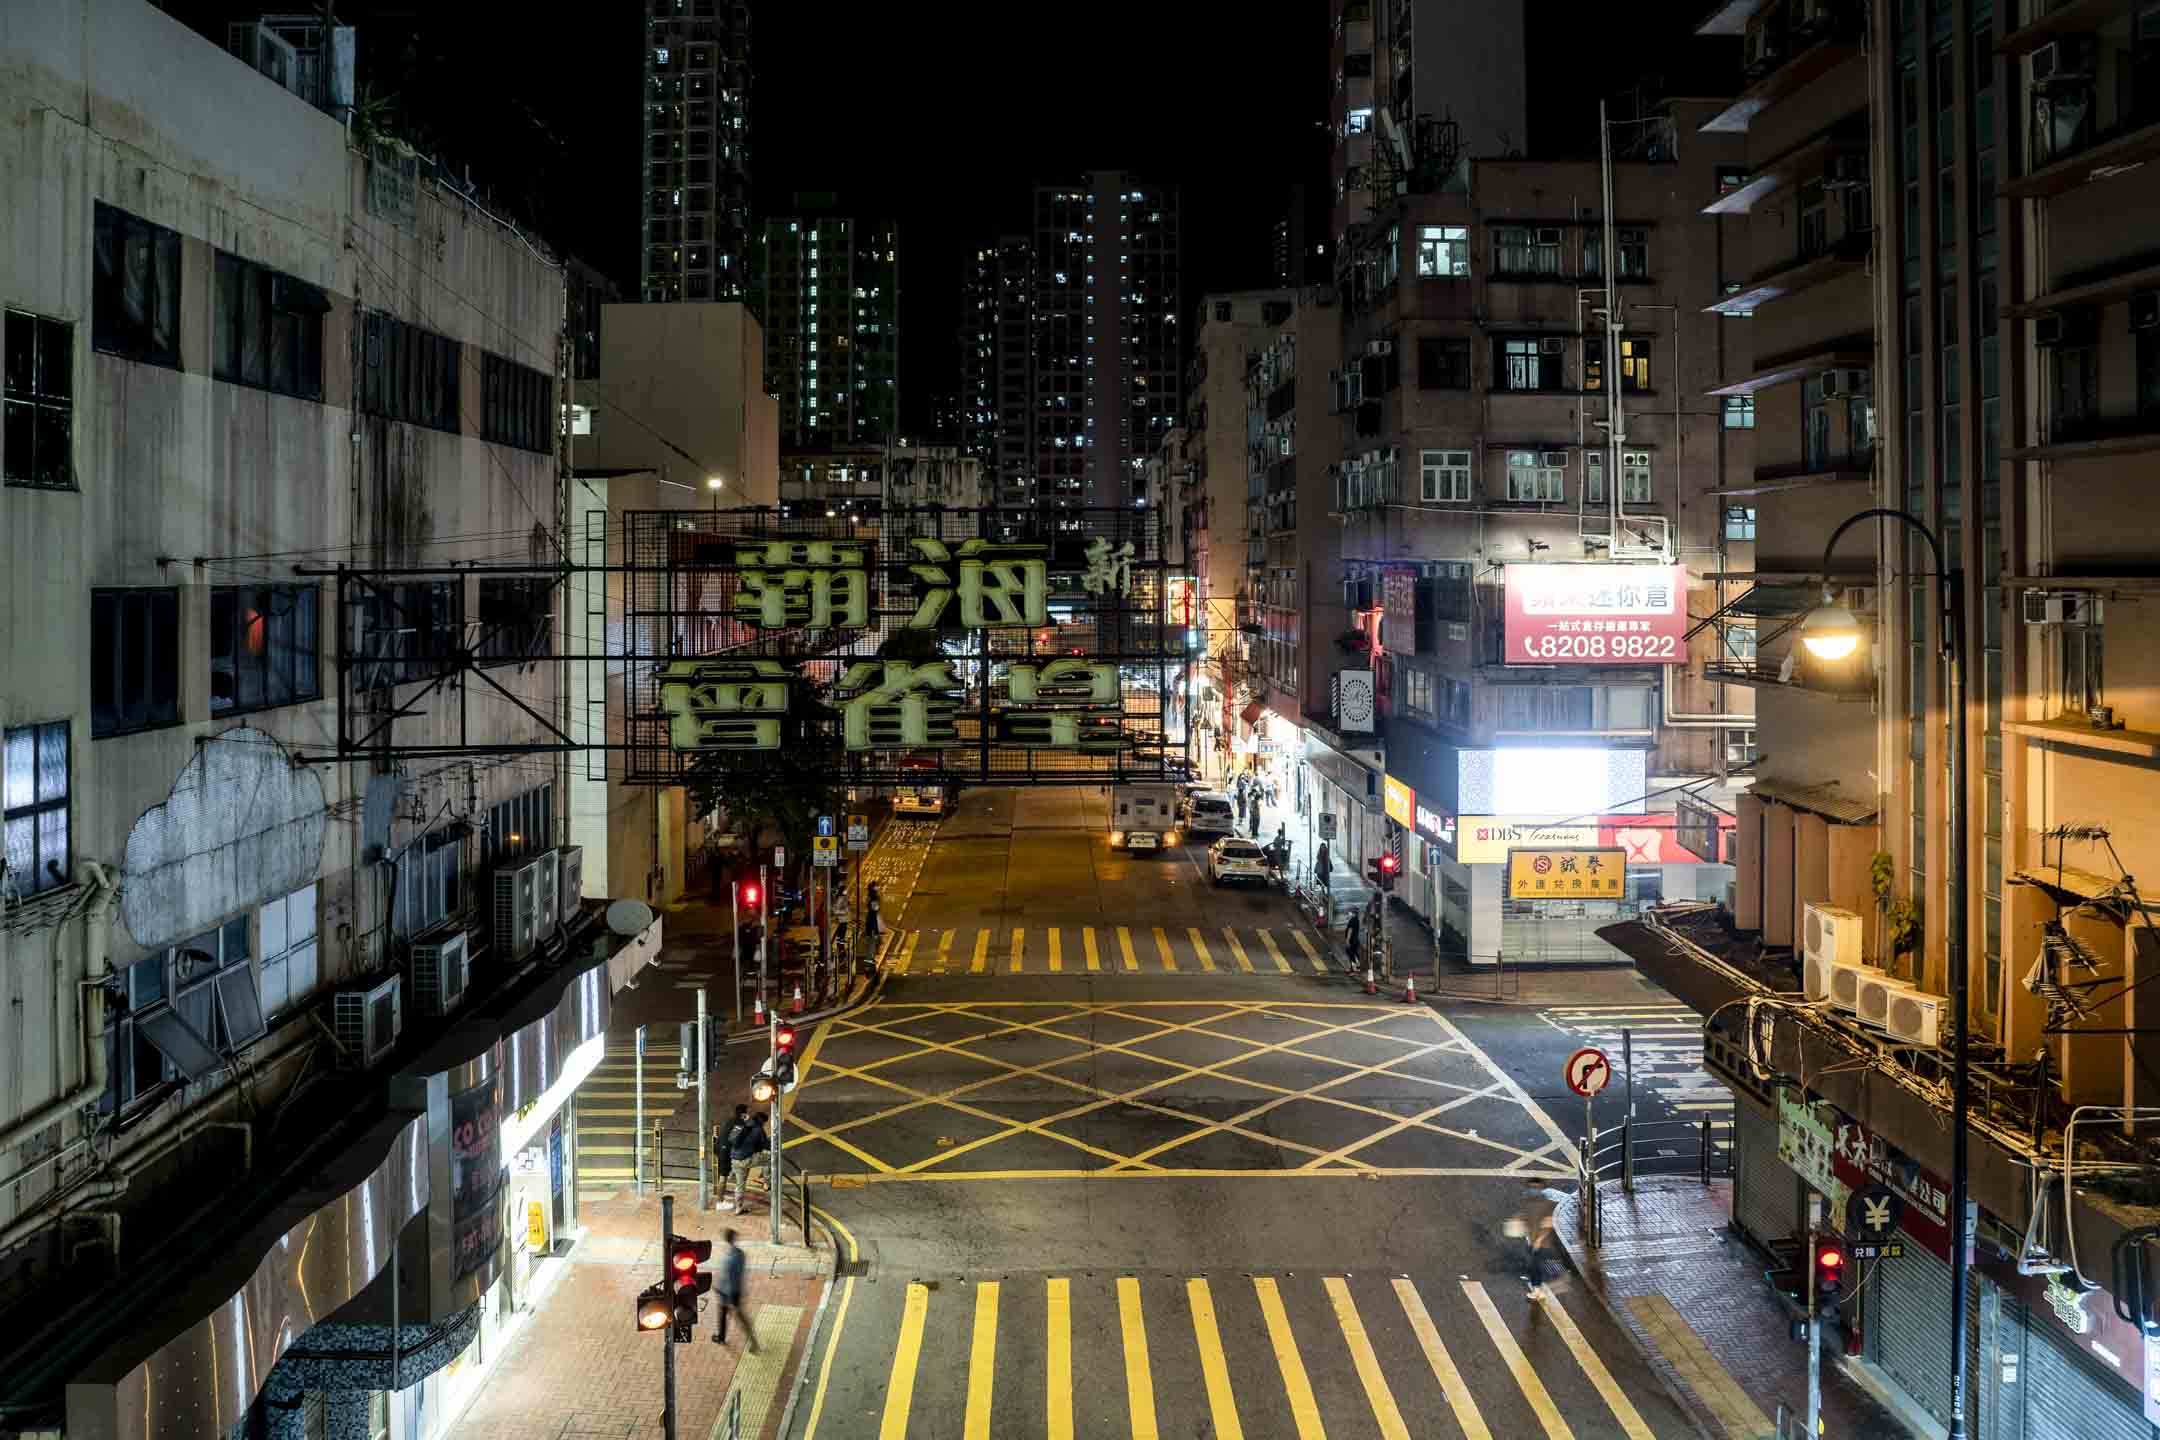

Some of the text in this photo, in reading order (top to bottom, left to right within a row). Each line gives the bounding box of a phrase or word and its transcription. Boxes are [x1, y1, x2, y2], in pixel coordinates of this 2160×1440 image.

[1541, 635, 1675, 657] 8208 9822
[1491, 827, 1521, 841] DBS
